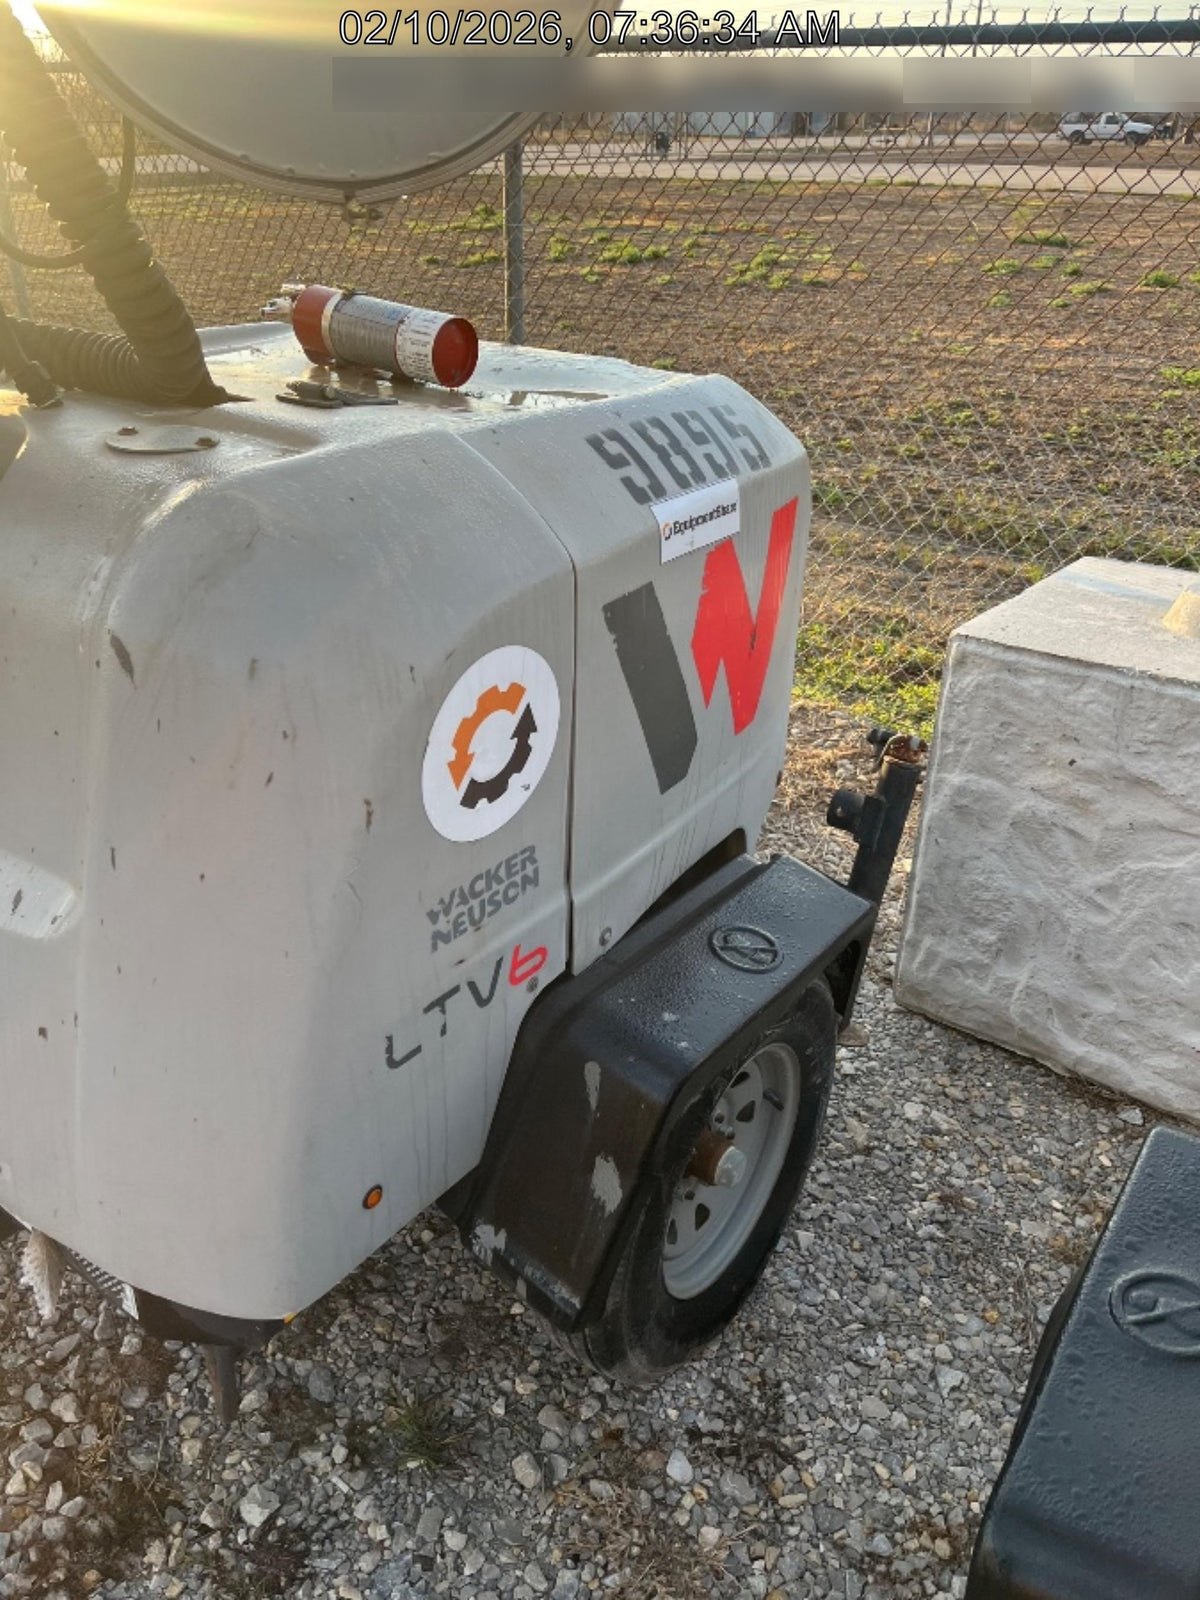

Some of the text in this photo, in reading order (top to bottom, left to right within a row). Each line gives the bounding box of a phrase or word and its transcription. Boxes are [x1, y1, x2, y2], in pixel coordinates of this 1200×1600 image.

[585, 404, 773, 505] 9895
[426, 845, 538, 926] WACKER
[430, 865, 539, 953] NEUSON
